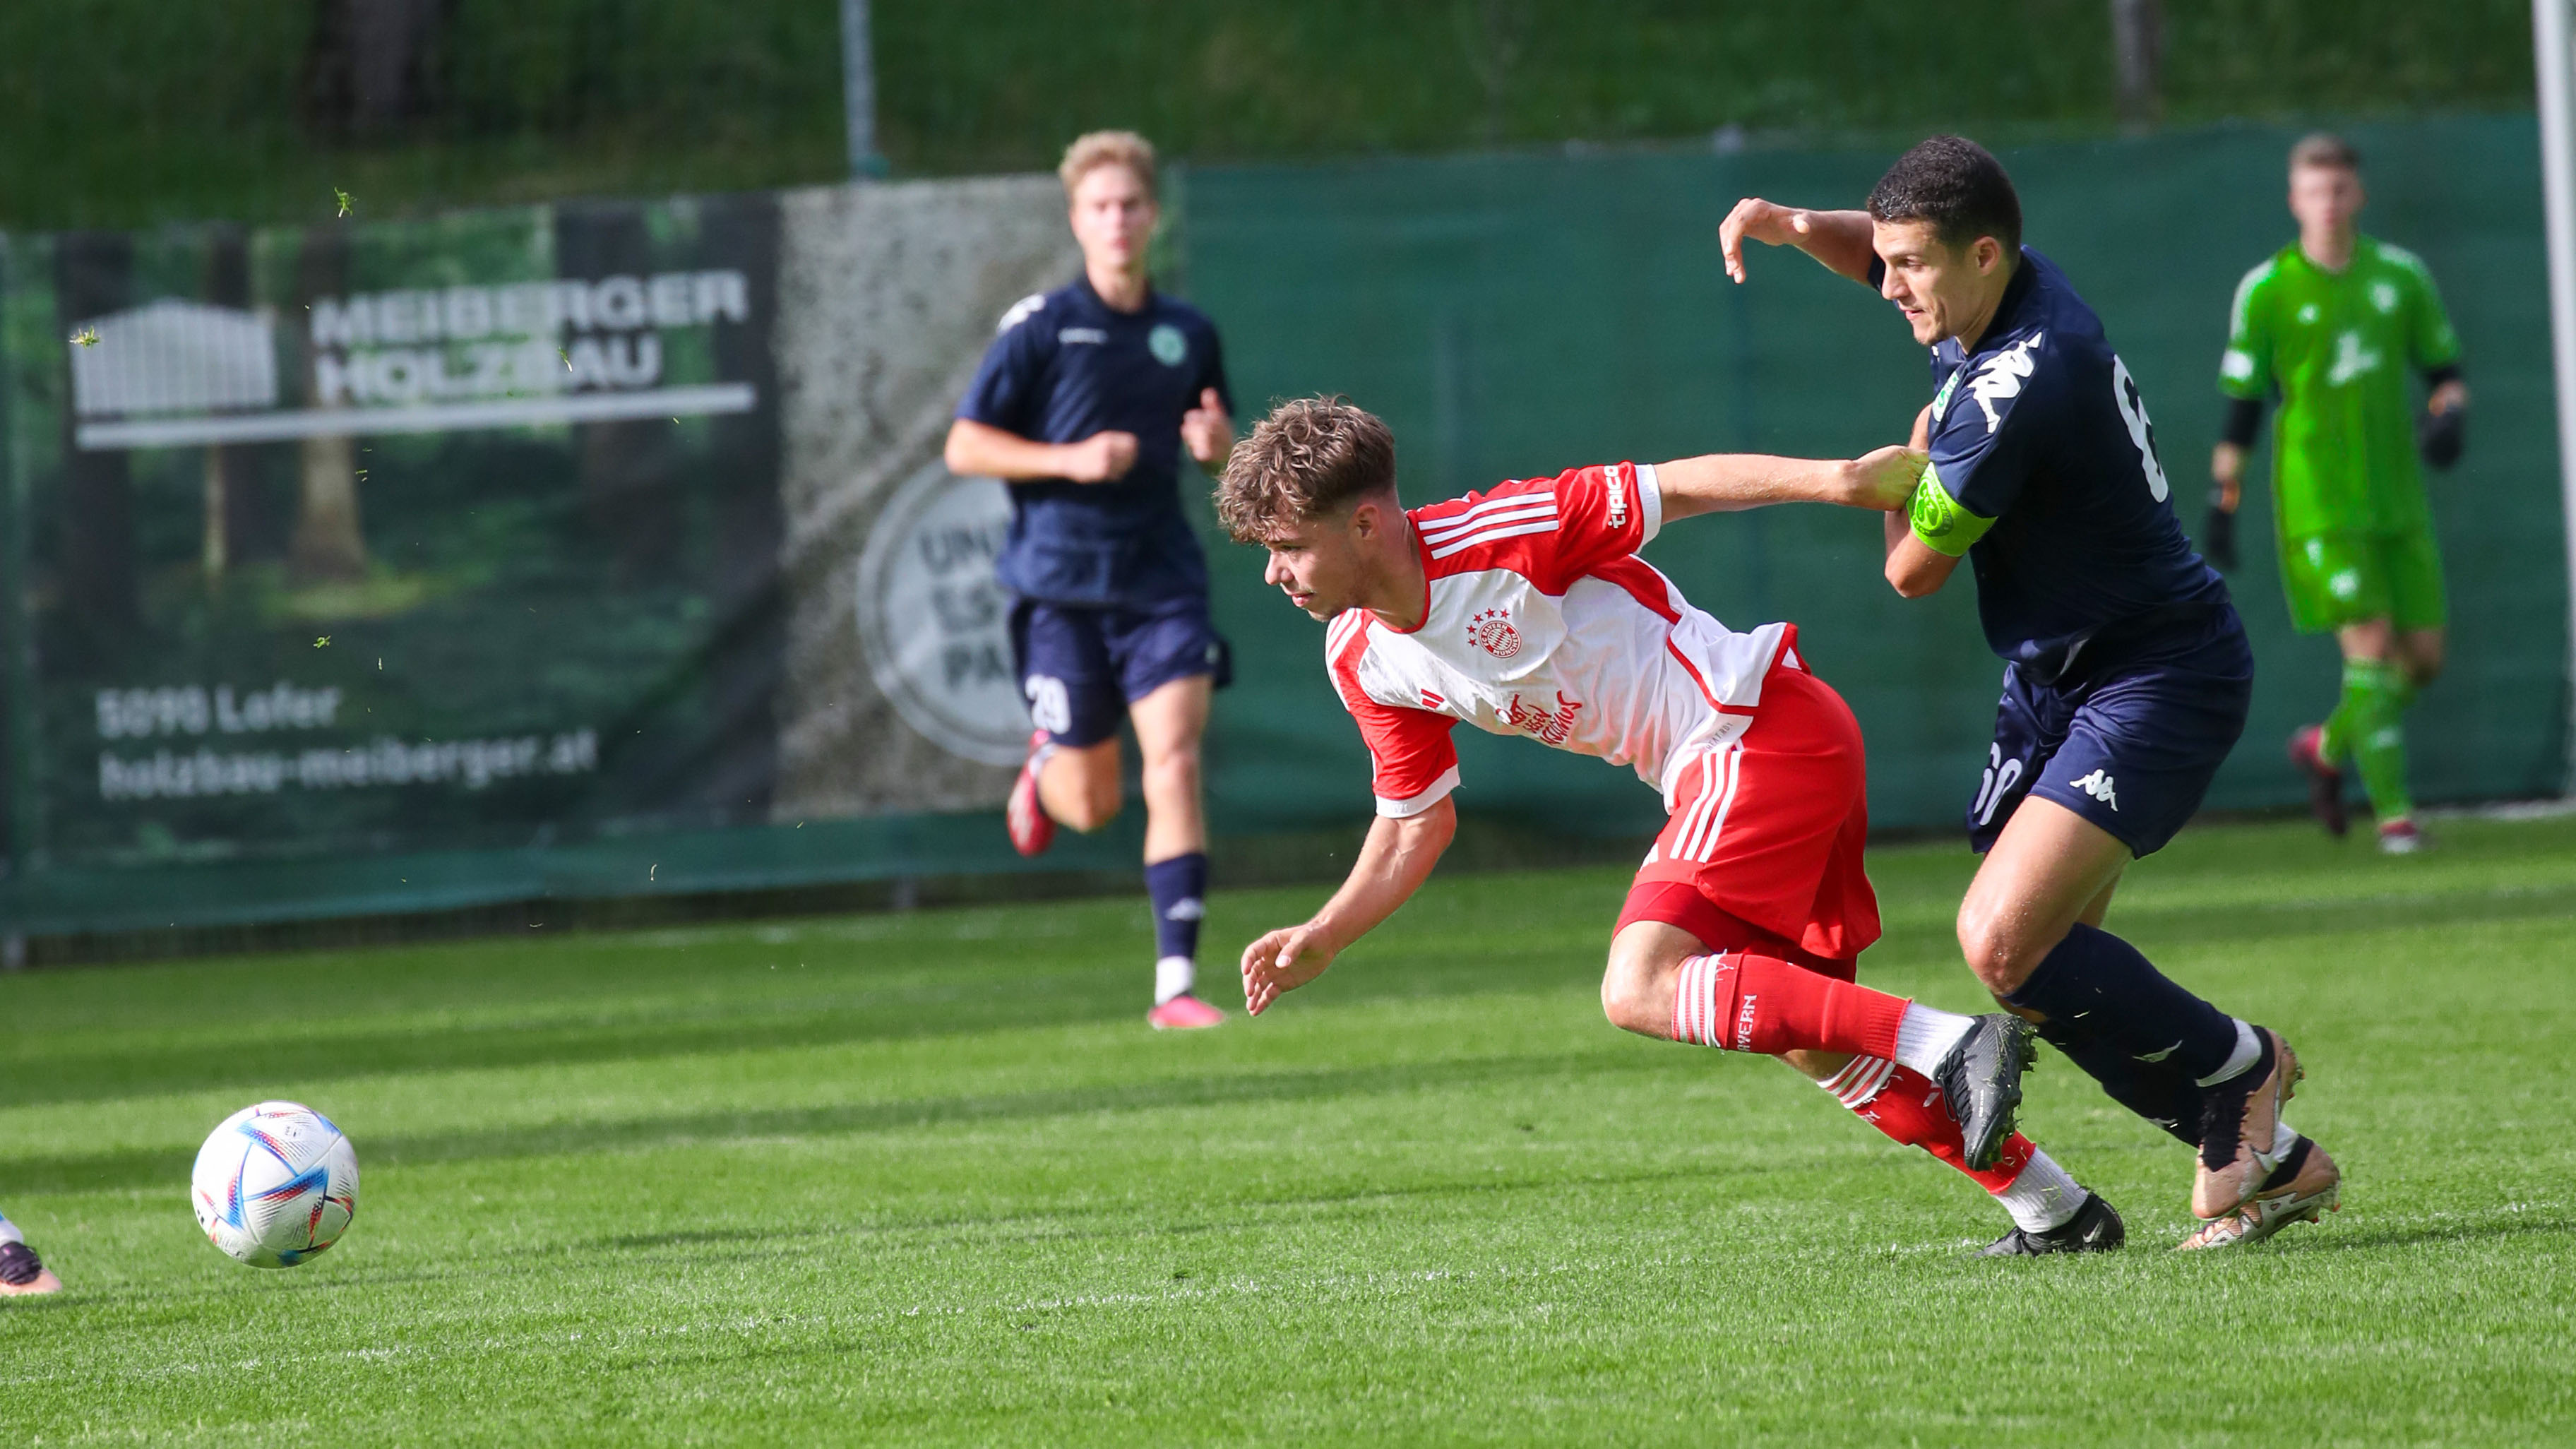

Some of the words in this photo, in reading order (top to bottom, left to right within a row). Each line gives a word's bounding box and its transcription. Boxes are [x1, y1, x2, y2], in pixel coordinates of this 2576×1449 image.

[311, 270, 749, 346] MEIBERGER
[316, 334, 664, 407] HOLZBAU
[1604, 466, 1628, 529] tipico
[215, 679, 341, 734] Lofer
[99, 727, 598, 802] holzbau-meiberger.at
[1737, 994, 1758, 1052] AYERN
